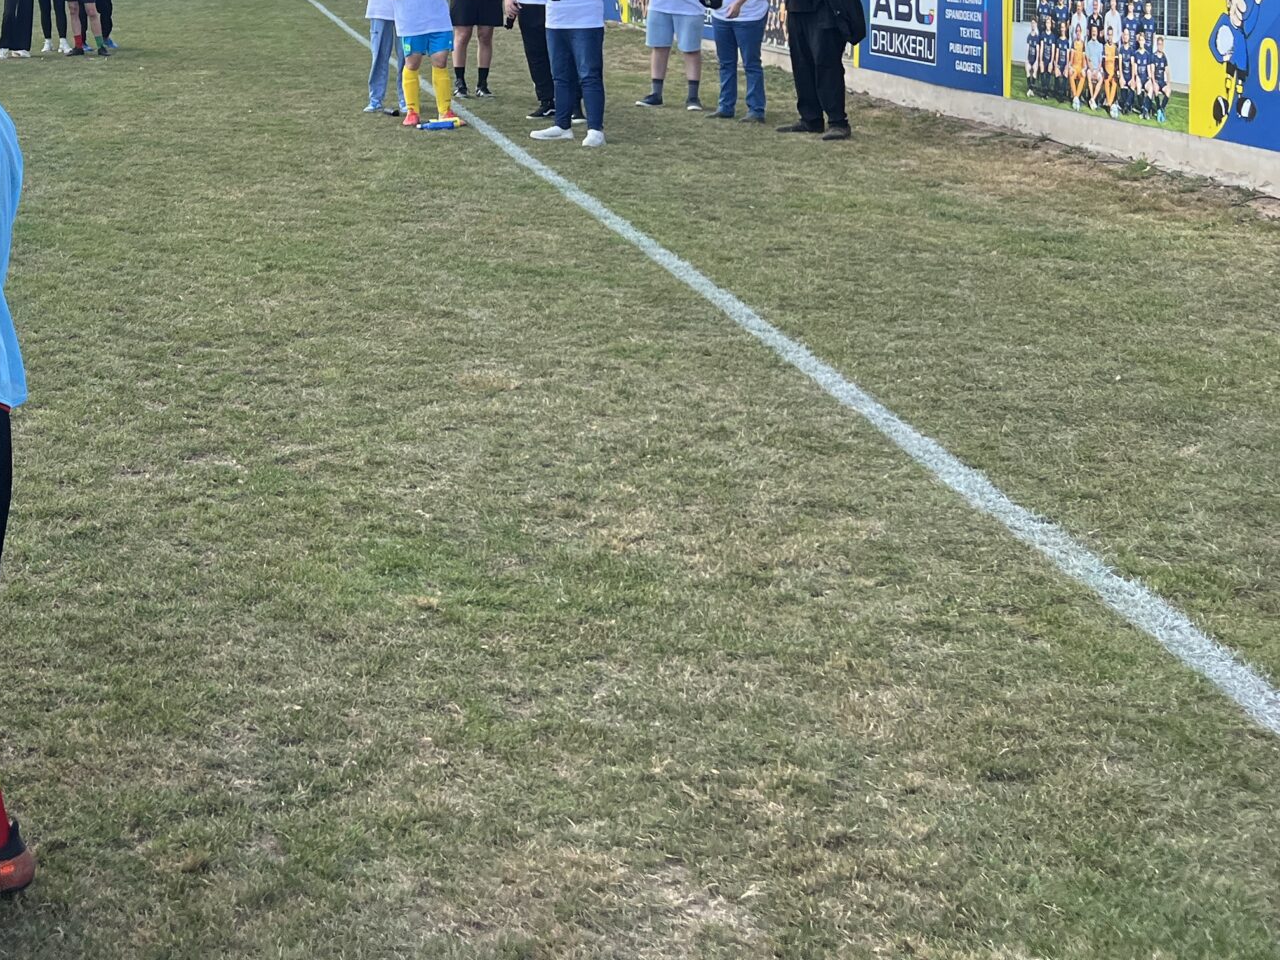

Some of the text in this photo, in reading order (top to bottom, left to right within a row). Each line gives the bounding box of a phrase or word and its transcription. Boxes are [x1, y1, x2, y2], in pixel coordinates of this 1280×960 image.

[945, 9, 982, 22] SPANDOEKEN
[959, 27, 982, 39] TEXTIEL
[871, 30, 934, 60] DRUKKERIJ
[949, 42, 982, 57] PUBLICITEIT
[955, 60, 982, 74] GADGETS
